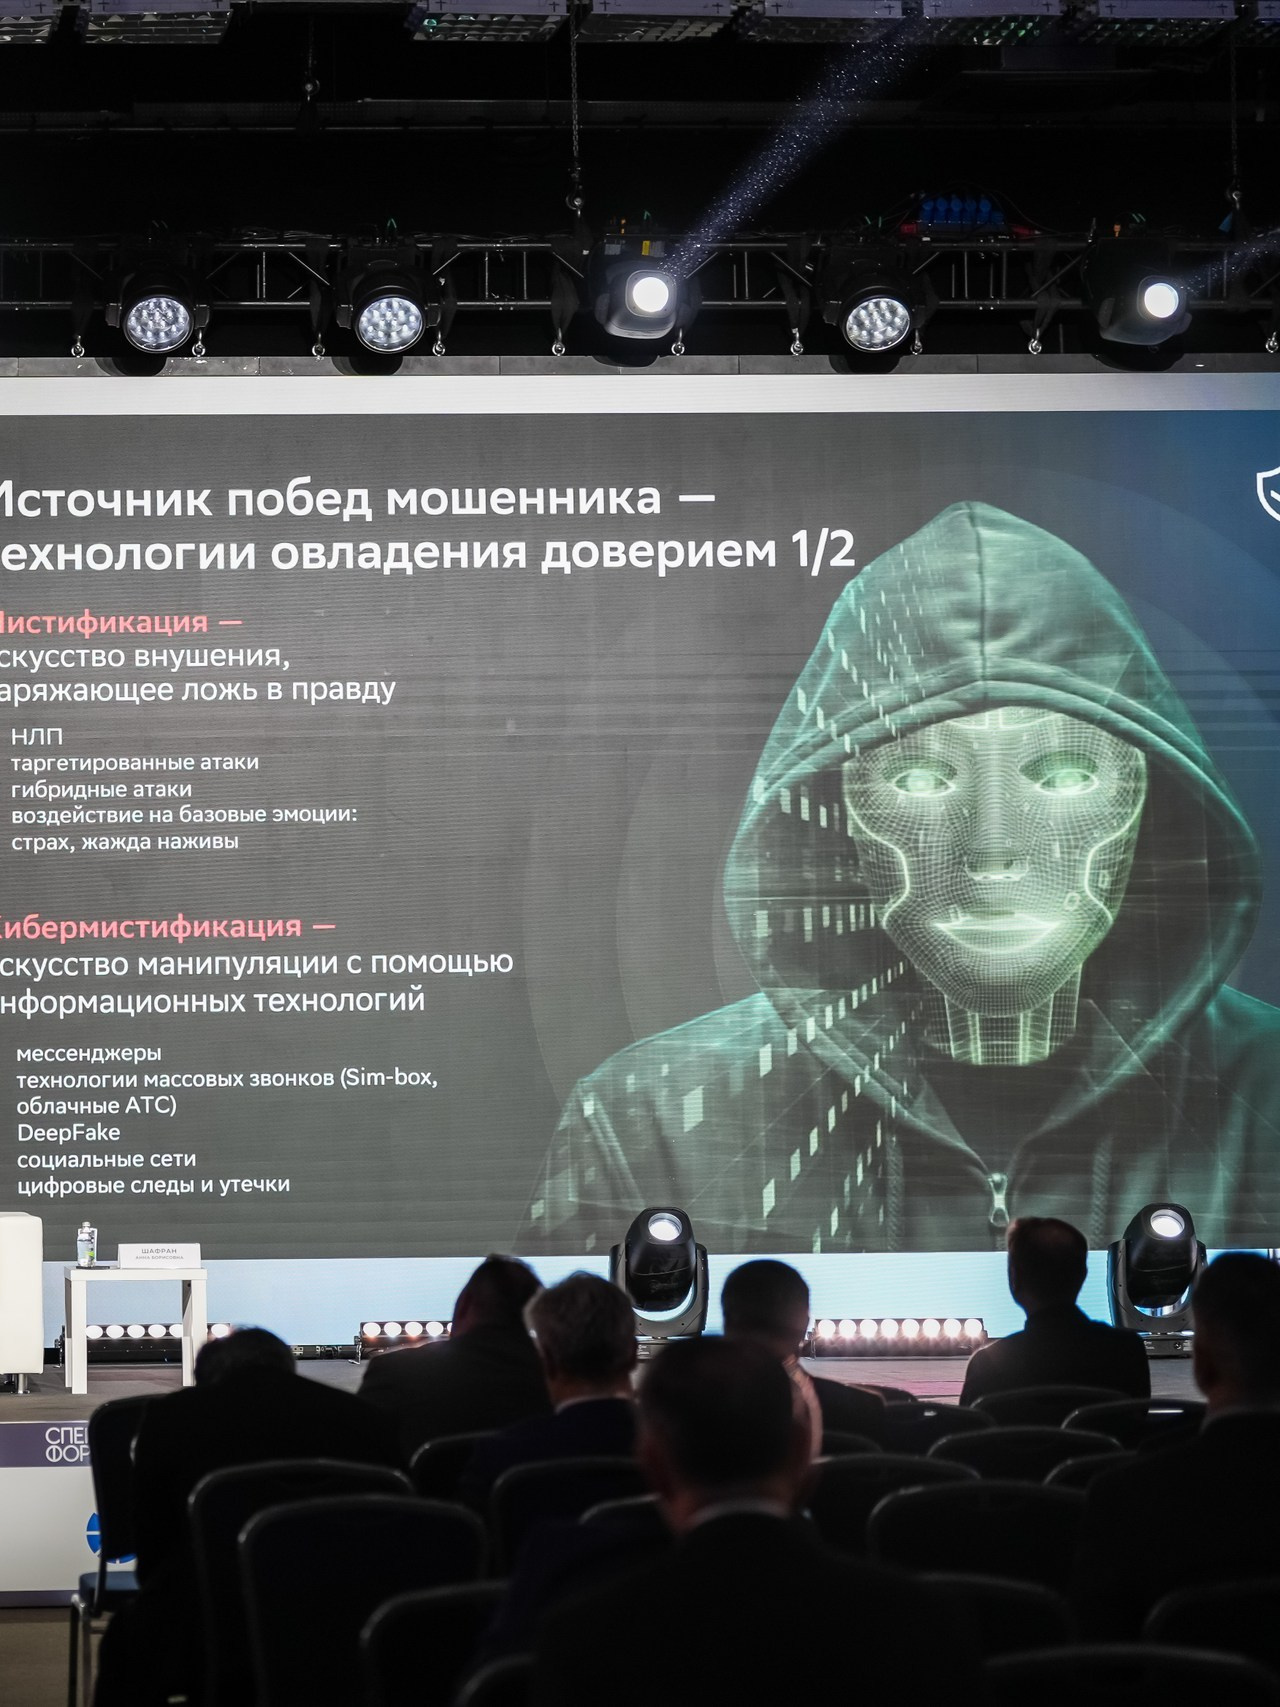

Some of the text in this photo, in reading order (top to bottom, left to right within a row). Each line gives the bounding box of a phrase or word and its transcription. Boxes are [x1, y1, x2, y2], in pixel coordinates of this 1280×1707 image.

[229, 476, 372, 521] побед
[388, 487, 660, 515] мошенника
[272, 542, 526, 573] овладения
[541, 540, 775, 577] доверием
[792, 528, 856, 576] 1/2
[135, 649, 289, 672] внушения,
[182, 683, 257, 700] ложь
[268, 682, 282, 699] в
[293, 682, 396, 705] правду
[12, 728, 62, 745] НЛП
[11, 757, 258, 775] таргетированные атаки
[12, 779, 191, 801] гибридные атаки
[12, 804, 356, 826] воздействие на базовые эмоции:
[12, 837, 238, 854] страх, жажда наживы
[139, 956, 337, 980] манипуляции
[347, 955, 361, 973] с
[372, 954, 513, 976] помощью
[254, 985, 424, 1012] технологий
[17, 1048, 161, 1064] мессенджеры
[17, 1067, 437, 1089] технологии массовых звонков (Sim-box,
[17, 1095, 176, 1116] облачные АТС)
[19, 1122, 120, 1144] DeepFake
[18, 1154, 195, 1170] социальные сети
[19, 1176, 289, 1197] цифровые следы и утечки
